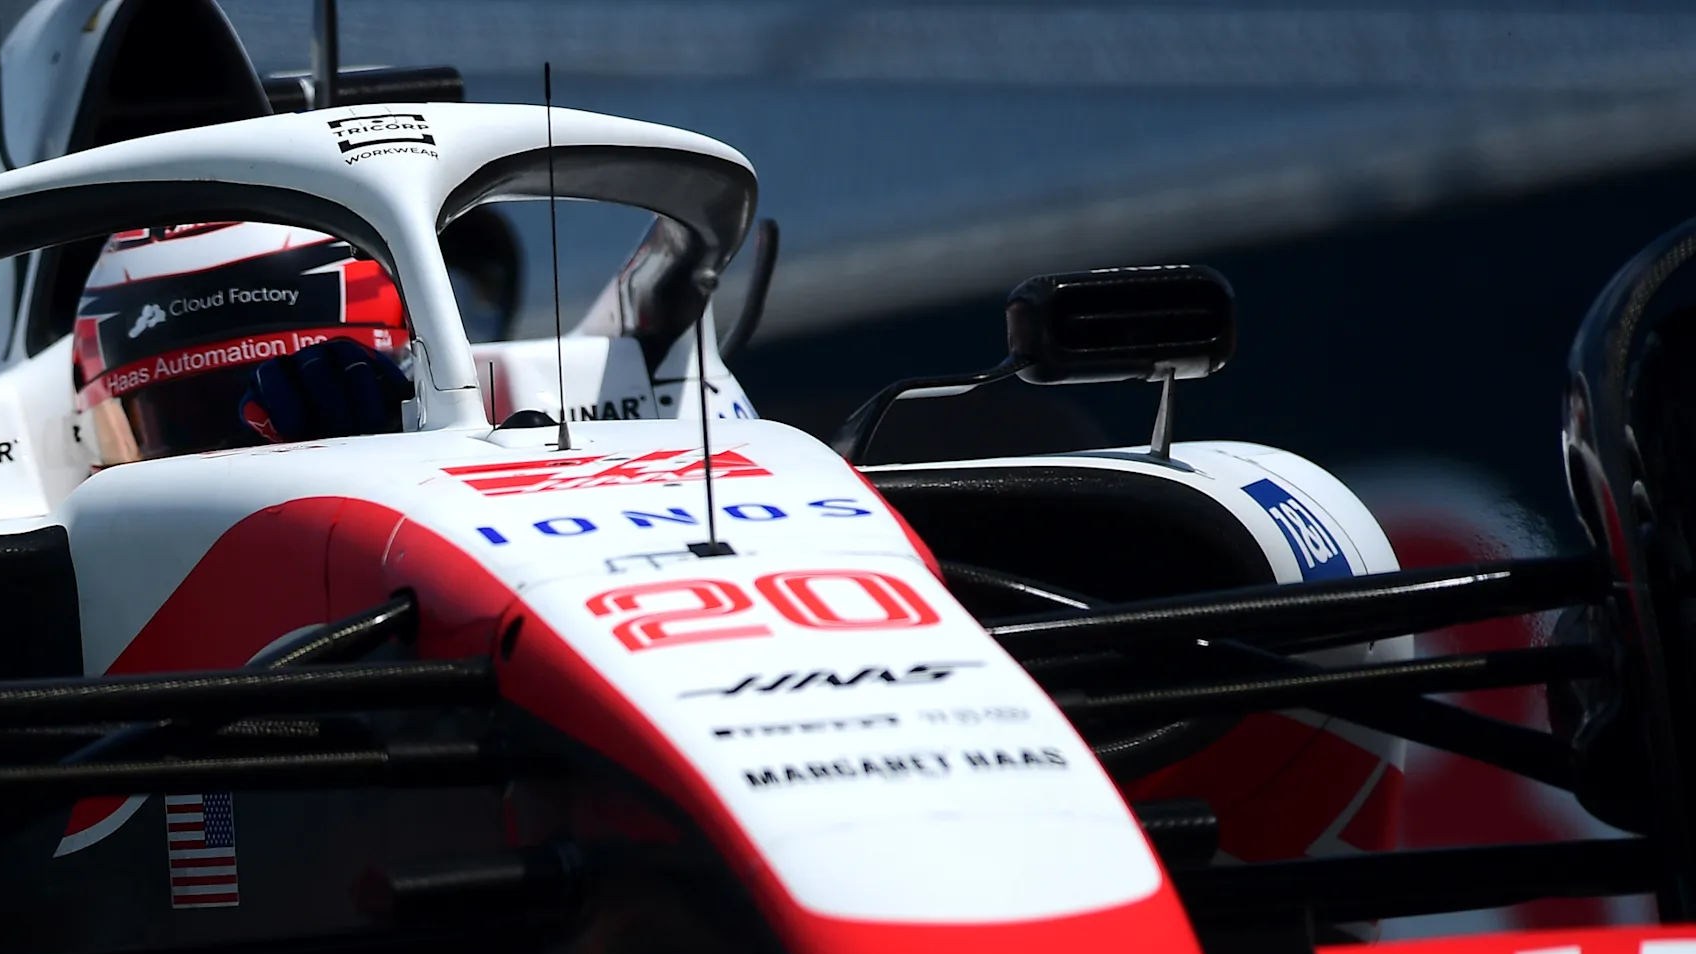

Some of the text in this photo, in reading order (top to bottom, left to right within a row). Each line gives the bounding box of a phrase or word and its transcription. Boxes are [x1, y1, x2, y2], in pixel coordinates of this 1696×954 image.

[332, 124, 430, 138] TRICORP
[344, 147, 440, 166] WORKWEAR
[168, 287, 299, 317] Cloud Factory
[106, 367, 151, 394] Haas
[154, 338, 287, 379] Automation
[475, 498, 873, 545] IONOS
[585, 568, 942, 654] 20
[682, 663, 984, 698] HAAS
[742, 746, 1068, 788] MARGARET HAAS
